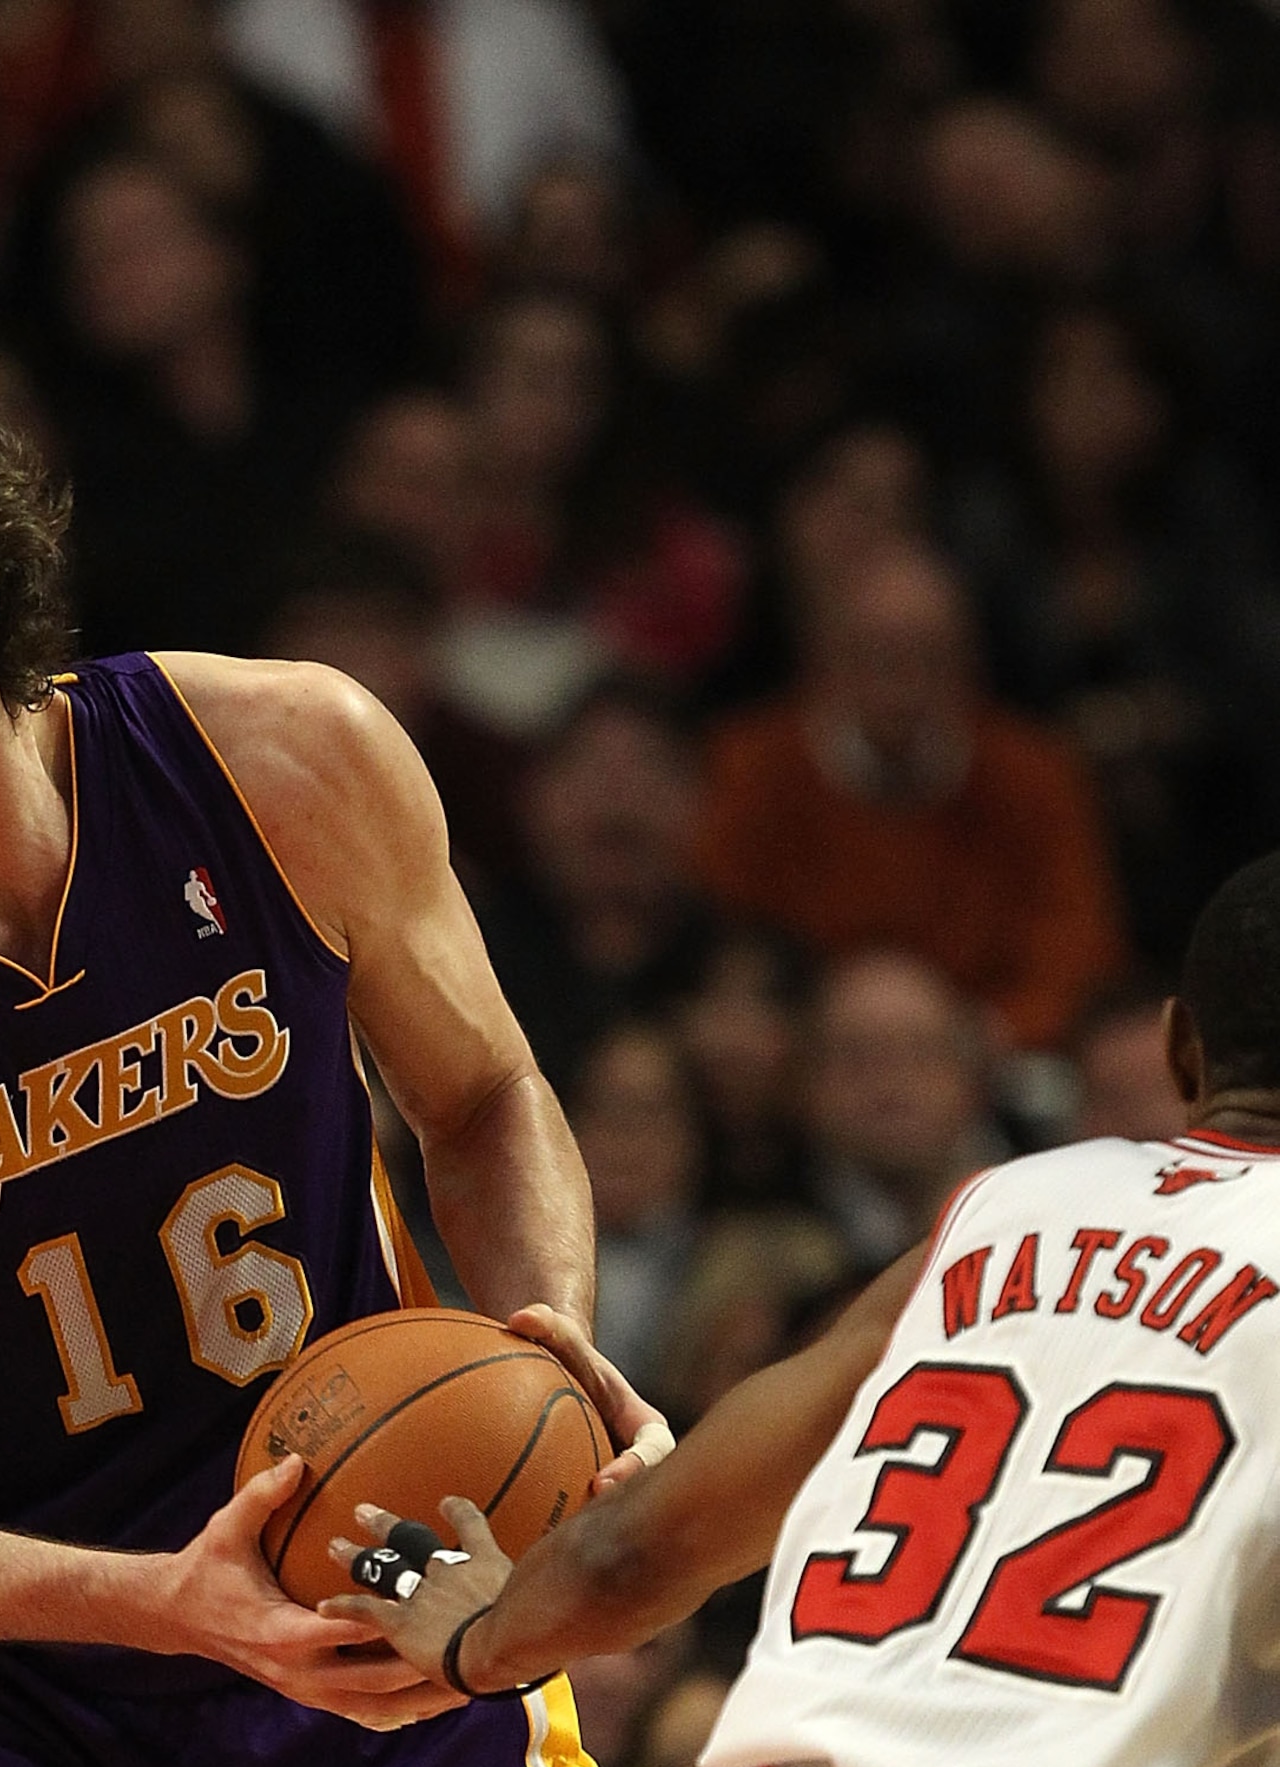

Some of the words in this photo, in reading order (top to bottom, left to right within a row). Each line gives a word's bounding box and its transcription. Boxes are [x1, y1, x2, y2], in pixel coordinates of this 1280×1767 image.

[16, 1163, 314, 1436] 16
[941, 1228, 1280, 1356] WATSON
[790, 1361, 1238, 1693] 32
